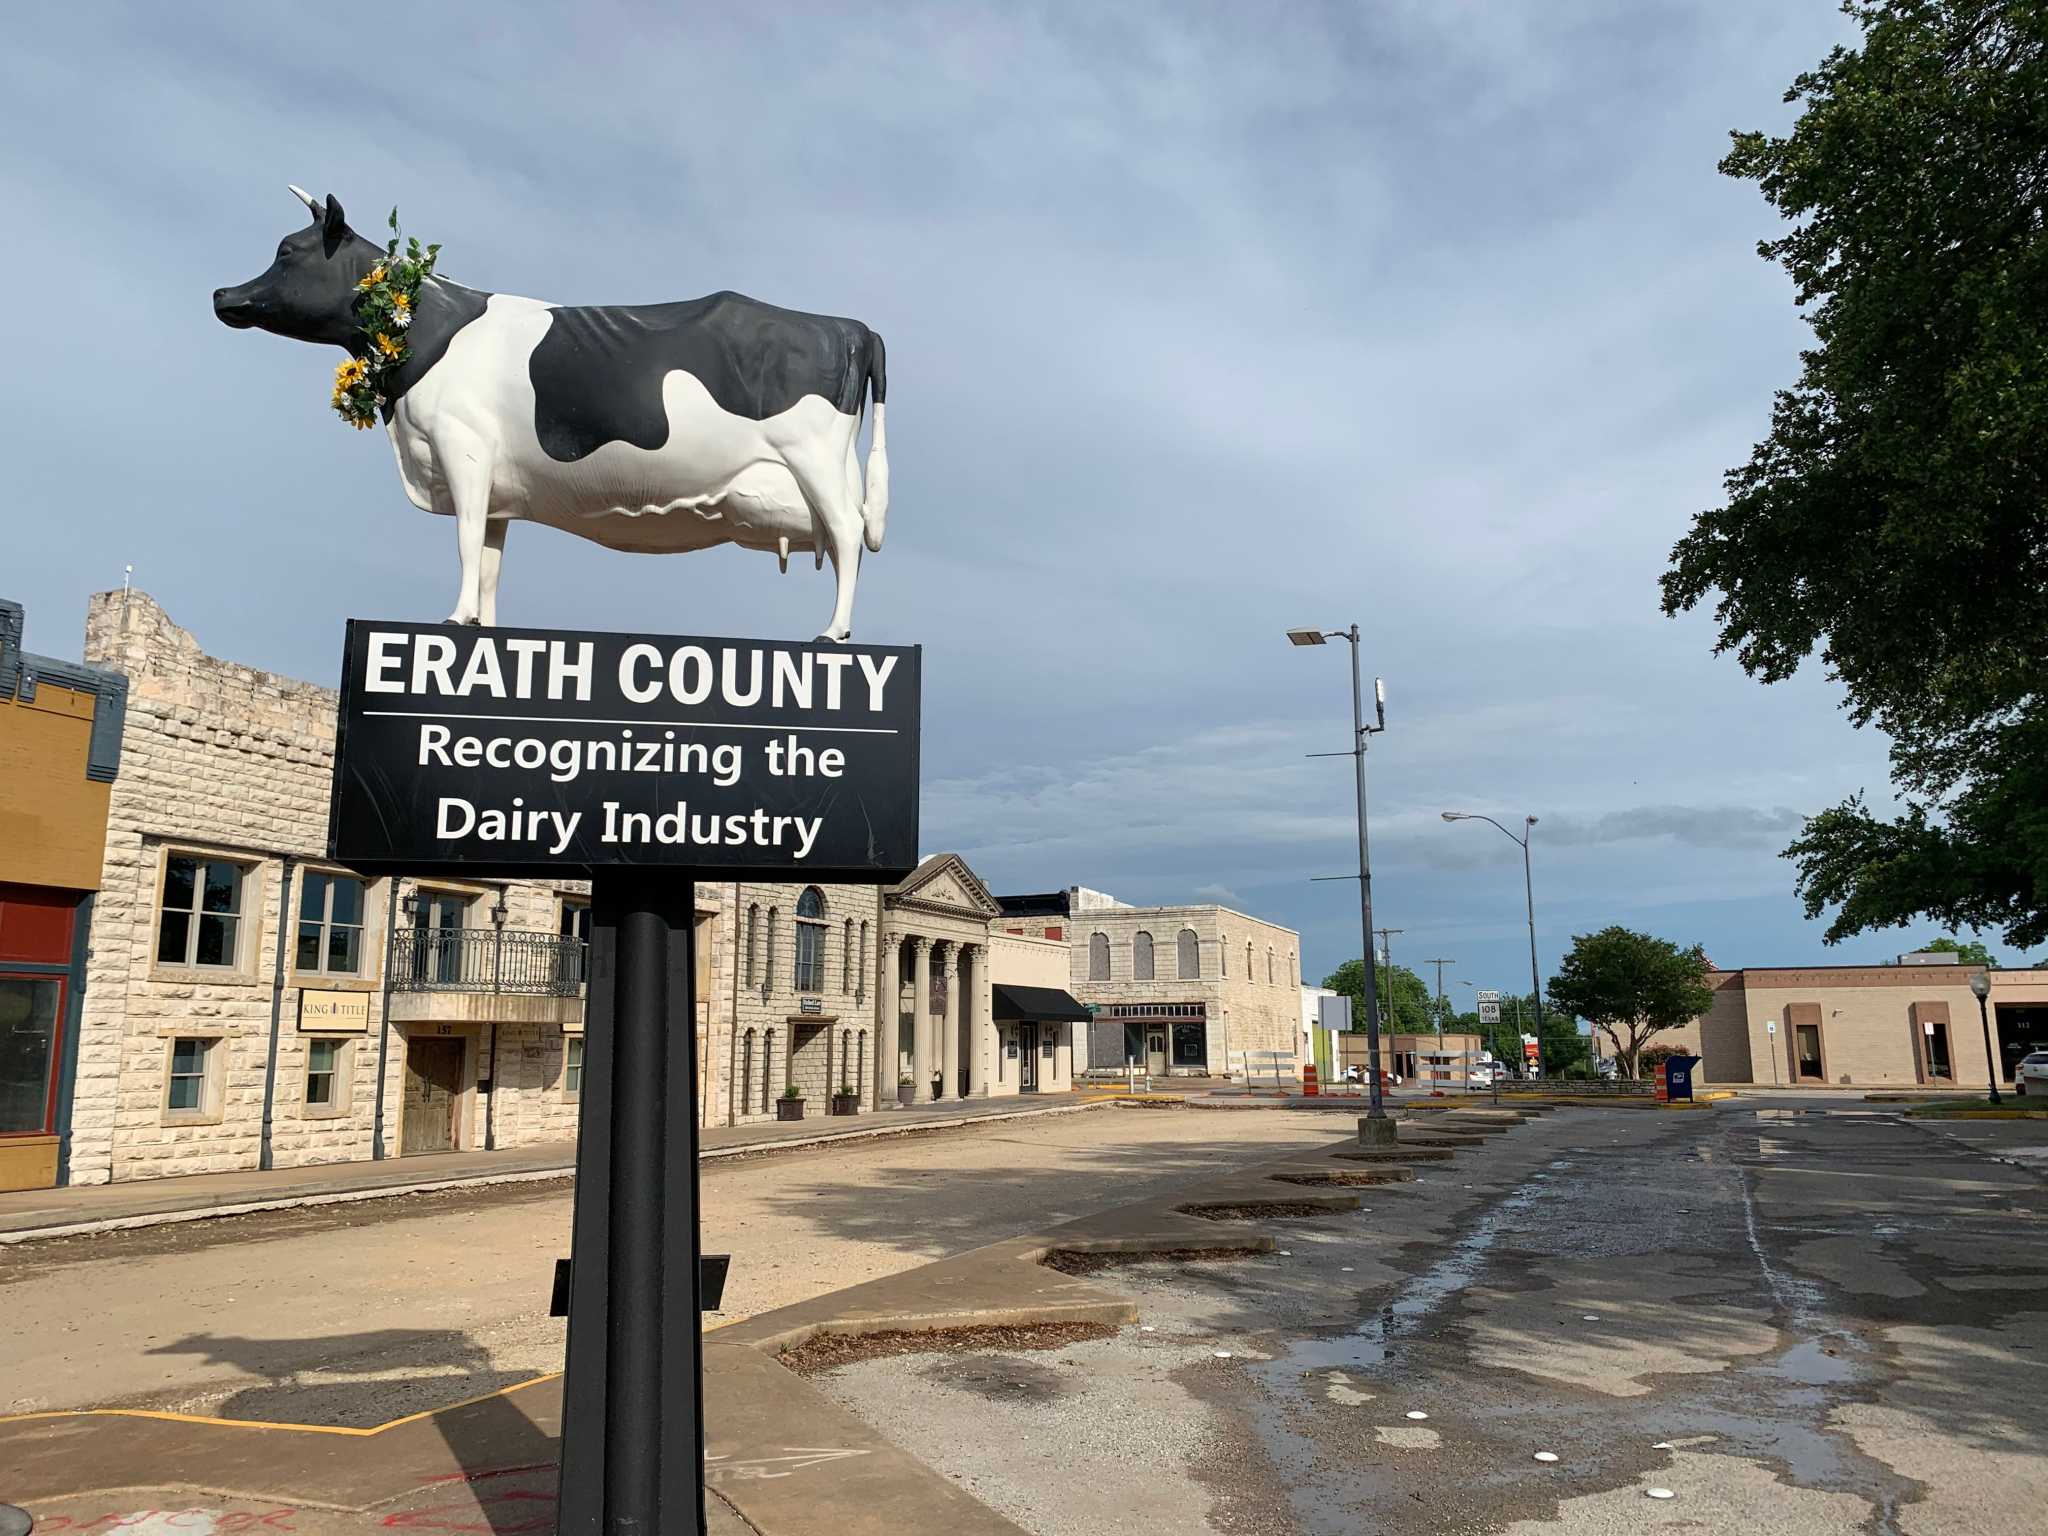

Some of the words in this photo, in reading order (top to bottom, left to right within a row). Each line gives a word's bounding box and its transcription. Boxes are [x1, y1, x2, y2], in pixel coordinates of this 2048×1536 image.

[364, 631, 594, 703] ERATH
[618, 643, 899, 712] COUNTY
[418, 724, 742, 787] Recognizing
[764, 734, 846, 778] the
[436, 797, 582, 855] Dairy
[601, 801, 823, 859] Industry
[304, 1003, 328, 1015] KING
[341, 1005, 366, 1016] TITLE
[1478, 991, 1499, 999] SOUTH
[1482, 1005, 1496, 1013] 108
